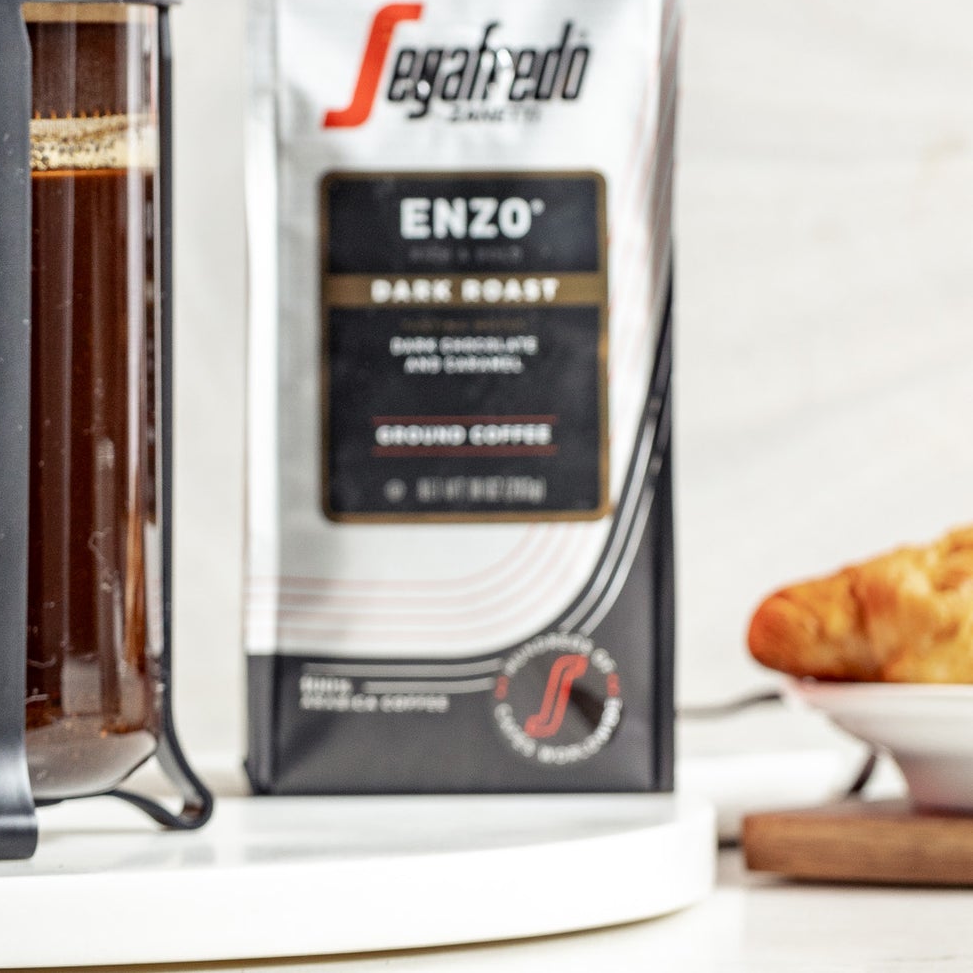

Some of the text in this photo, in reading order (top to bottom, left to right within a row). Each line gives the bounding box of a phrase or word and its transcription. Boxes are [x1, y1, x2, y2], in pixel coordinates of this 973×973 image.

[371, 279, 559, 303] DARK ROAST
[390, 335, 539, 356] DARK CHOCOLATE
[404, 355, 524, 374] AND CARAMEL
[375, 424, 552, 446] GROUND COFFEE
[379, 694, 450, 713] COFFEE
